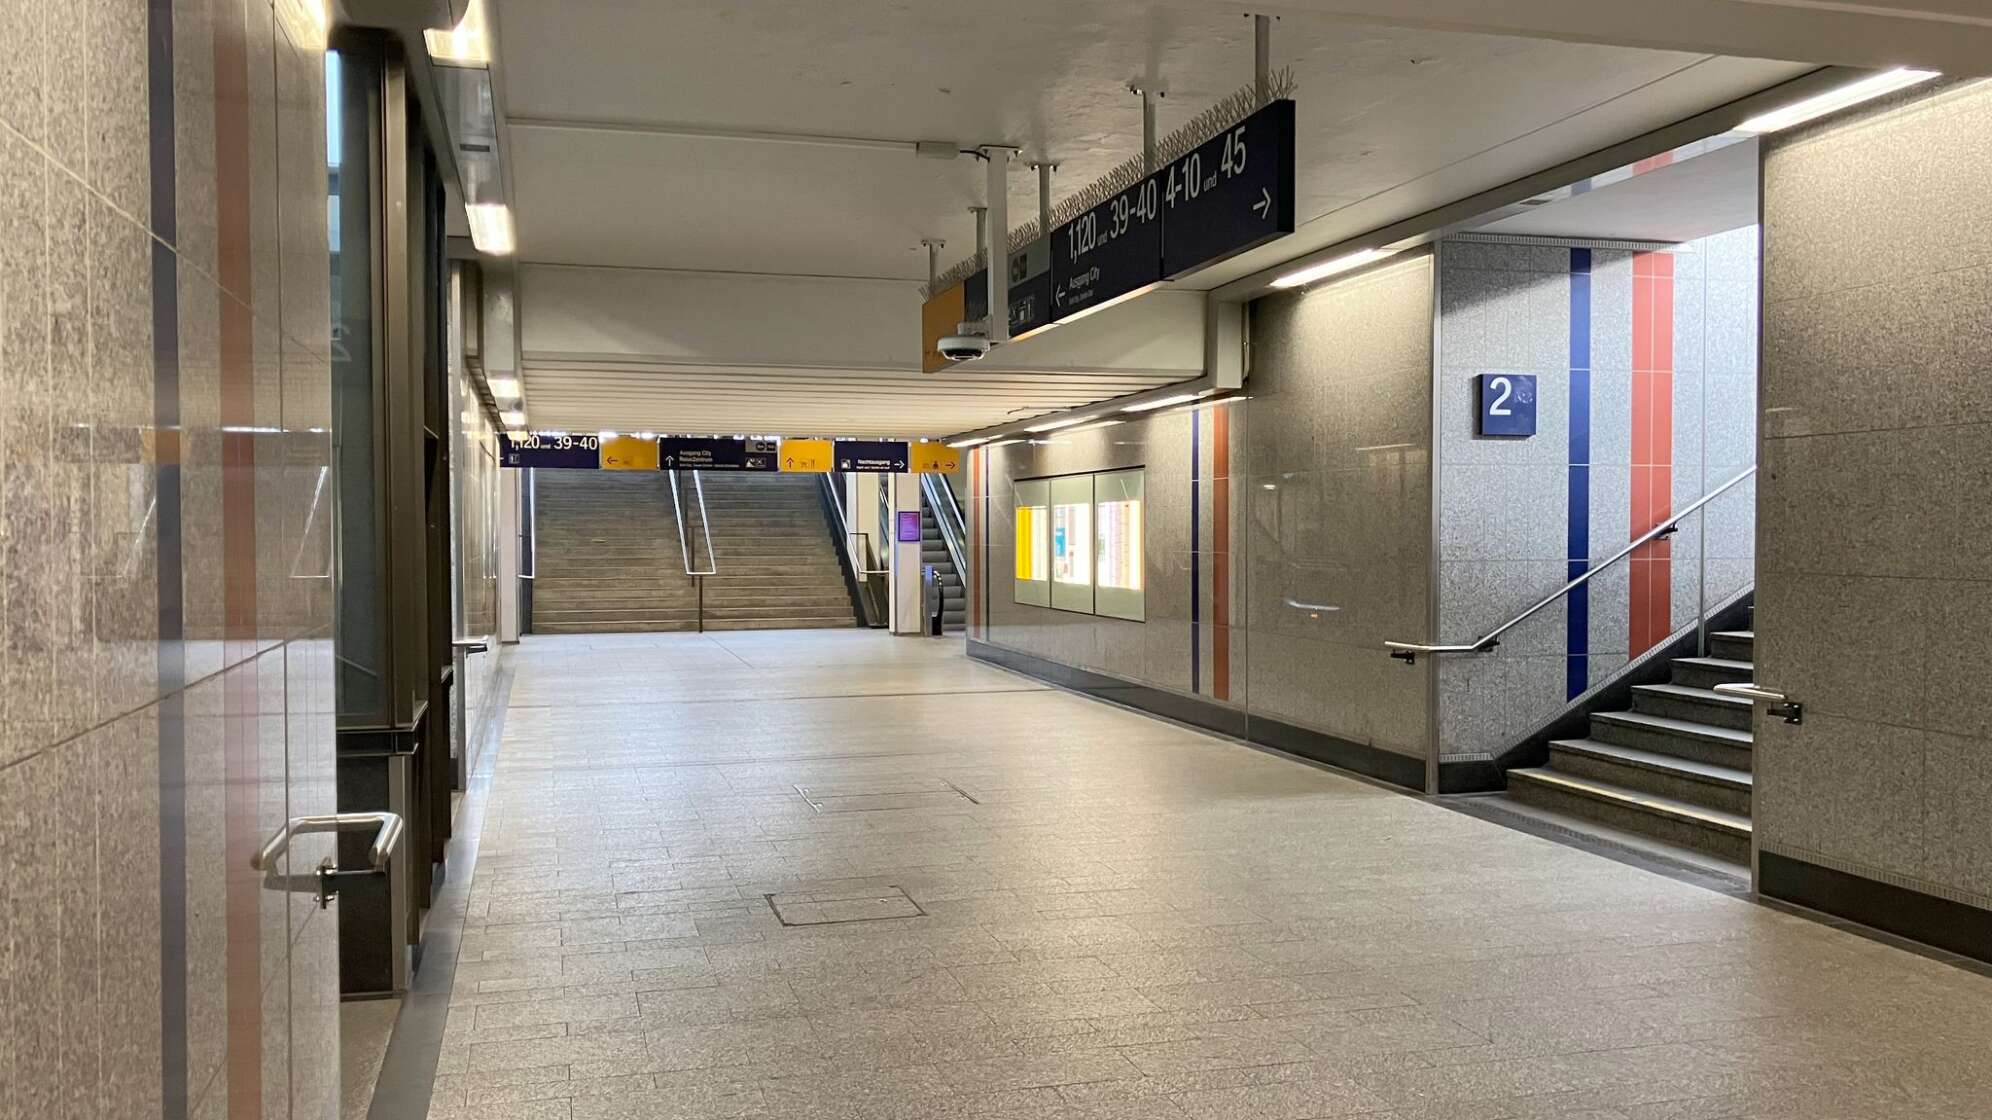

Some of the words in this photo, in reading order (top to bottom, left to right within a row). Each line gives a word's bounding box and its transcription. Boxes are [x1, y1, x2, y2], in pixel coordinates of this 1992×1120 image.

[1165, 152, 1200, 209] 4-10
[1203, 170, 1217, 192] und
[1221, 125, 1246, 178] 45
[1068, 210, 1096, 264] 1,120
[1110, 178, 1157, 239] 39-40
[1489, 376, 1511, 415] 2
[554, 436, 598, 450] 39-40
